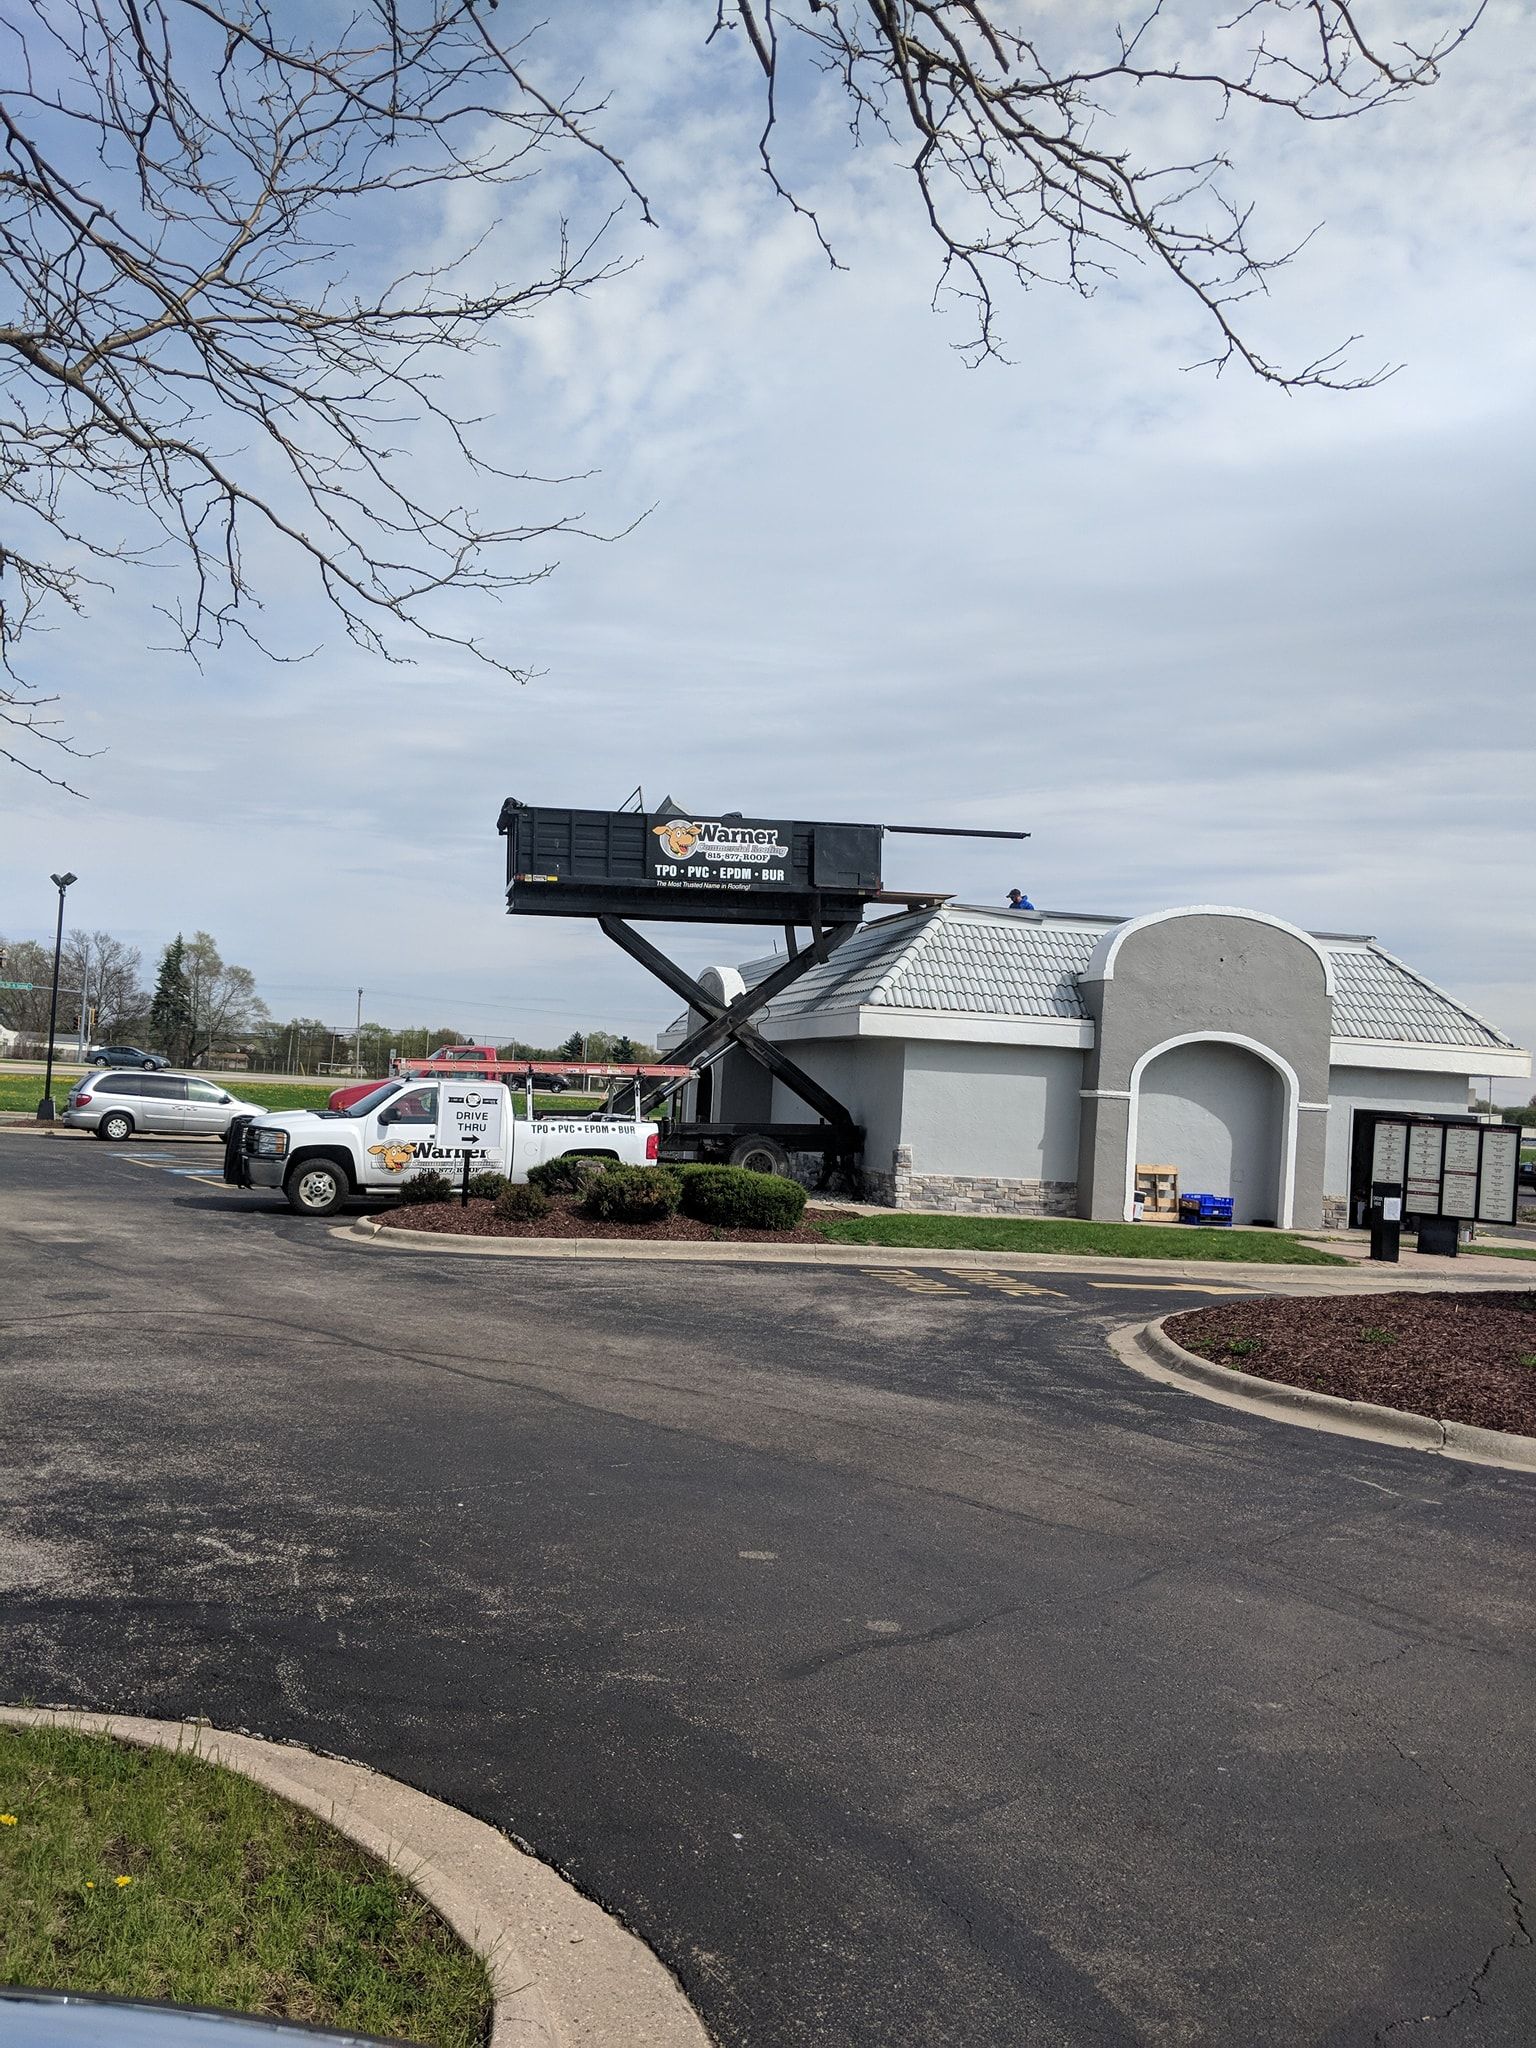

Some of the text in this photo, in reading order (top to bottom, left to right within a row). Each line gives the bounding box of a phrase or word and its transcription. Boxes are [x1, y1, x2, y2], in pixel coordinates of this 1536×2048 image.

[696, 823, 777, 844] Warner
[707, 852, 769, 862] 815-877-ROOF
[655, 864, 785, 881] TPO PVC EPDM BUR
[456, 1111, 488, 1121] DRIVE
[457, 1123, 487, 1132] THRU
[531, 1124, 548, 1134] TPO
[558, 1124, 575, 1134] PVC
[618, 1125, 636, 1135] BUR
